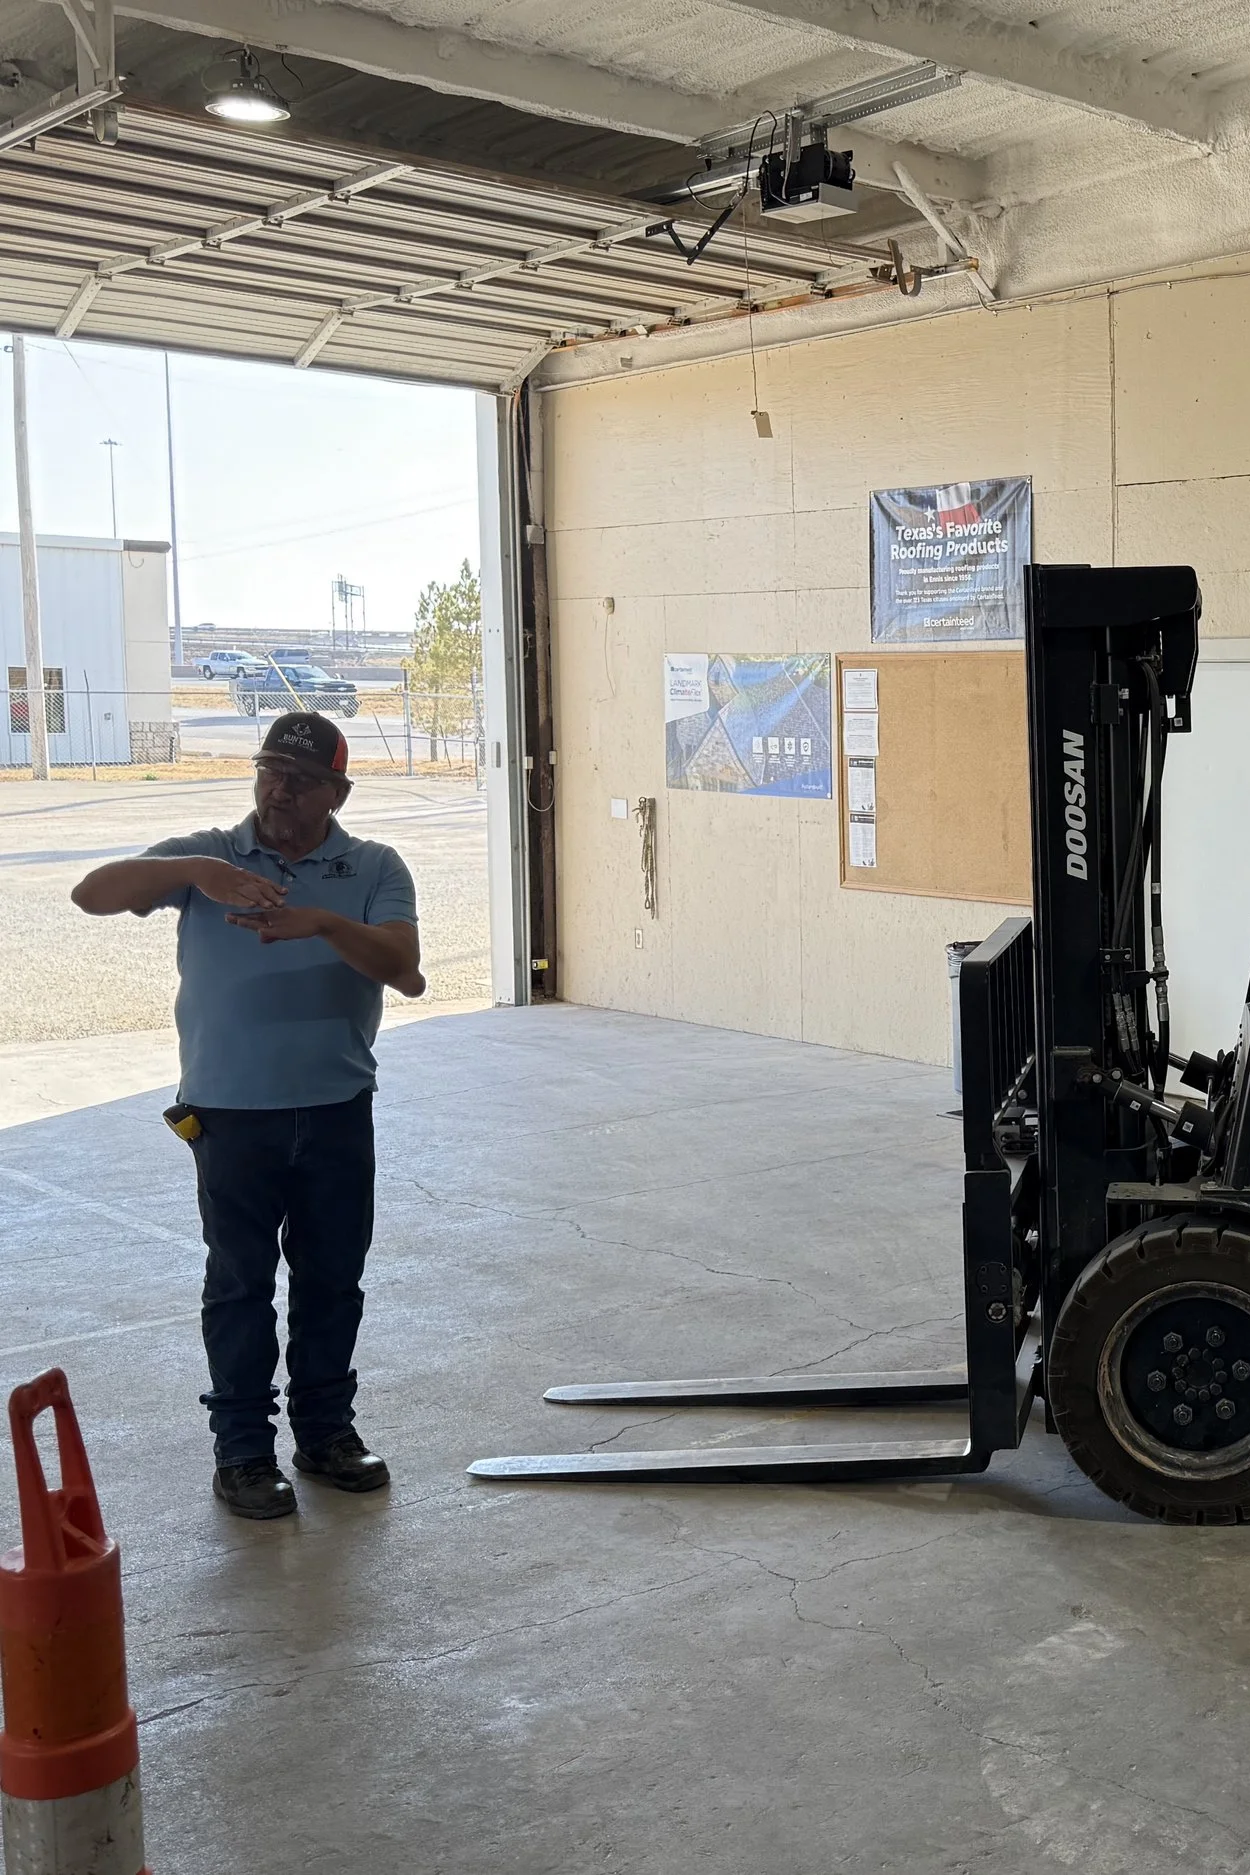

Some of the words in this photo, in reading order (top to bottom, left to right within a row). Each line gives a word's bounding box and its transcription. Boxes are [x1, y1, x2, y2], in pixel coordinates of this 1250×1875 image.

[895, 523, 944, 541] Texas's
[946, 519, 1002, 537] Favorite
[890, 543, 943, 561] Roofing
[945, 537, 1009, 557] Products
[917, 565, 955, 574] manufacturing
[955, 564, 976, 573] roofing
[976, 563, 1000, 572] products
[283, 733, 314, 748] BUNTON
[1062, 729, 1088, 881] DOOSAN
